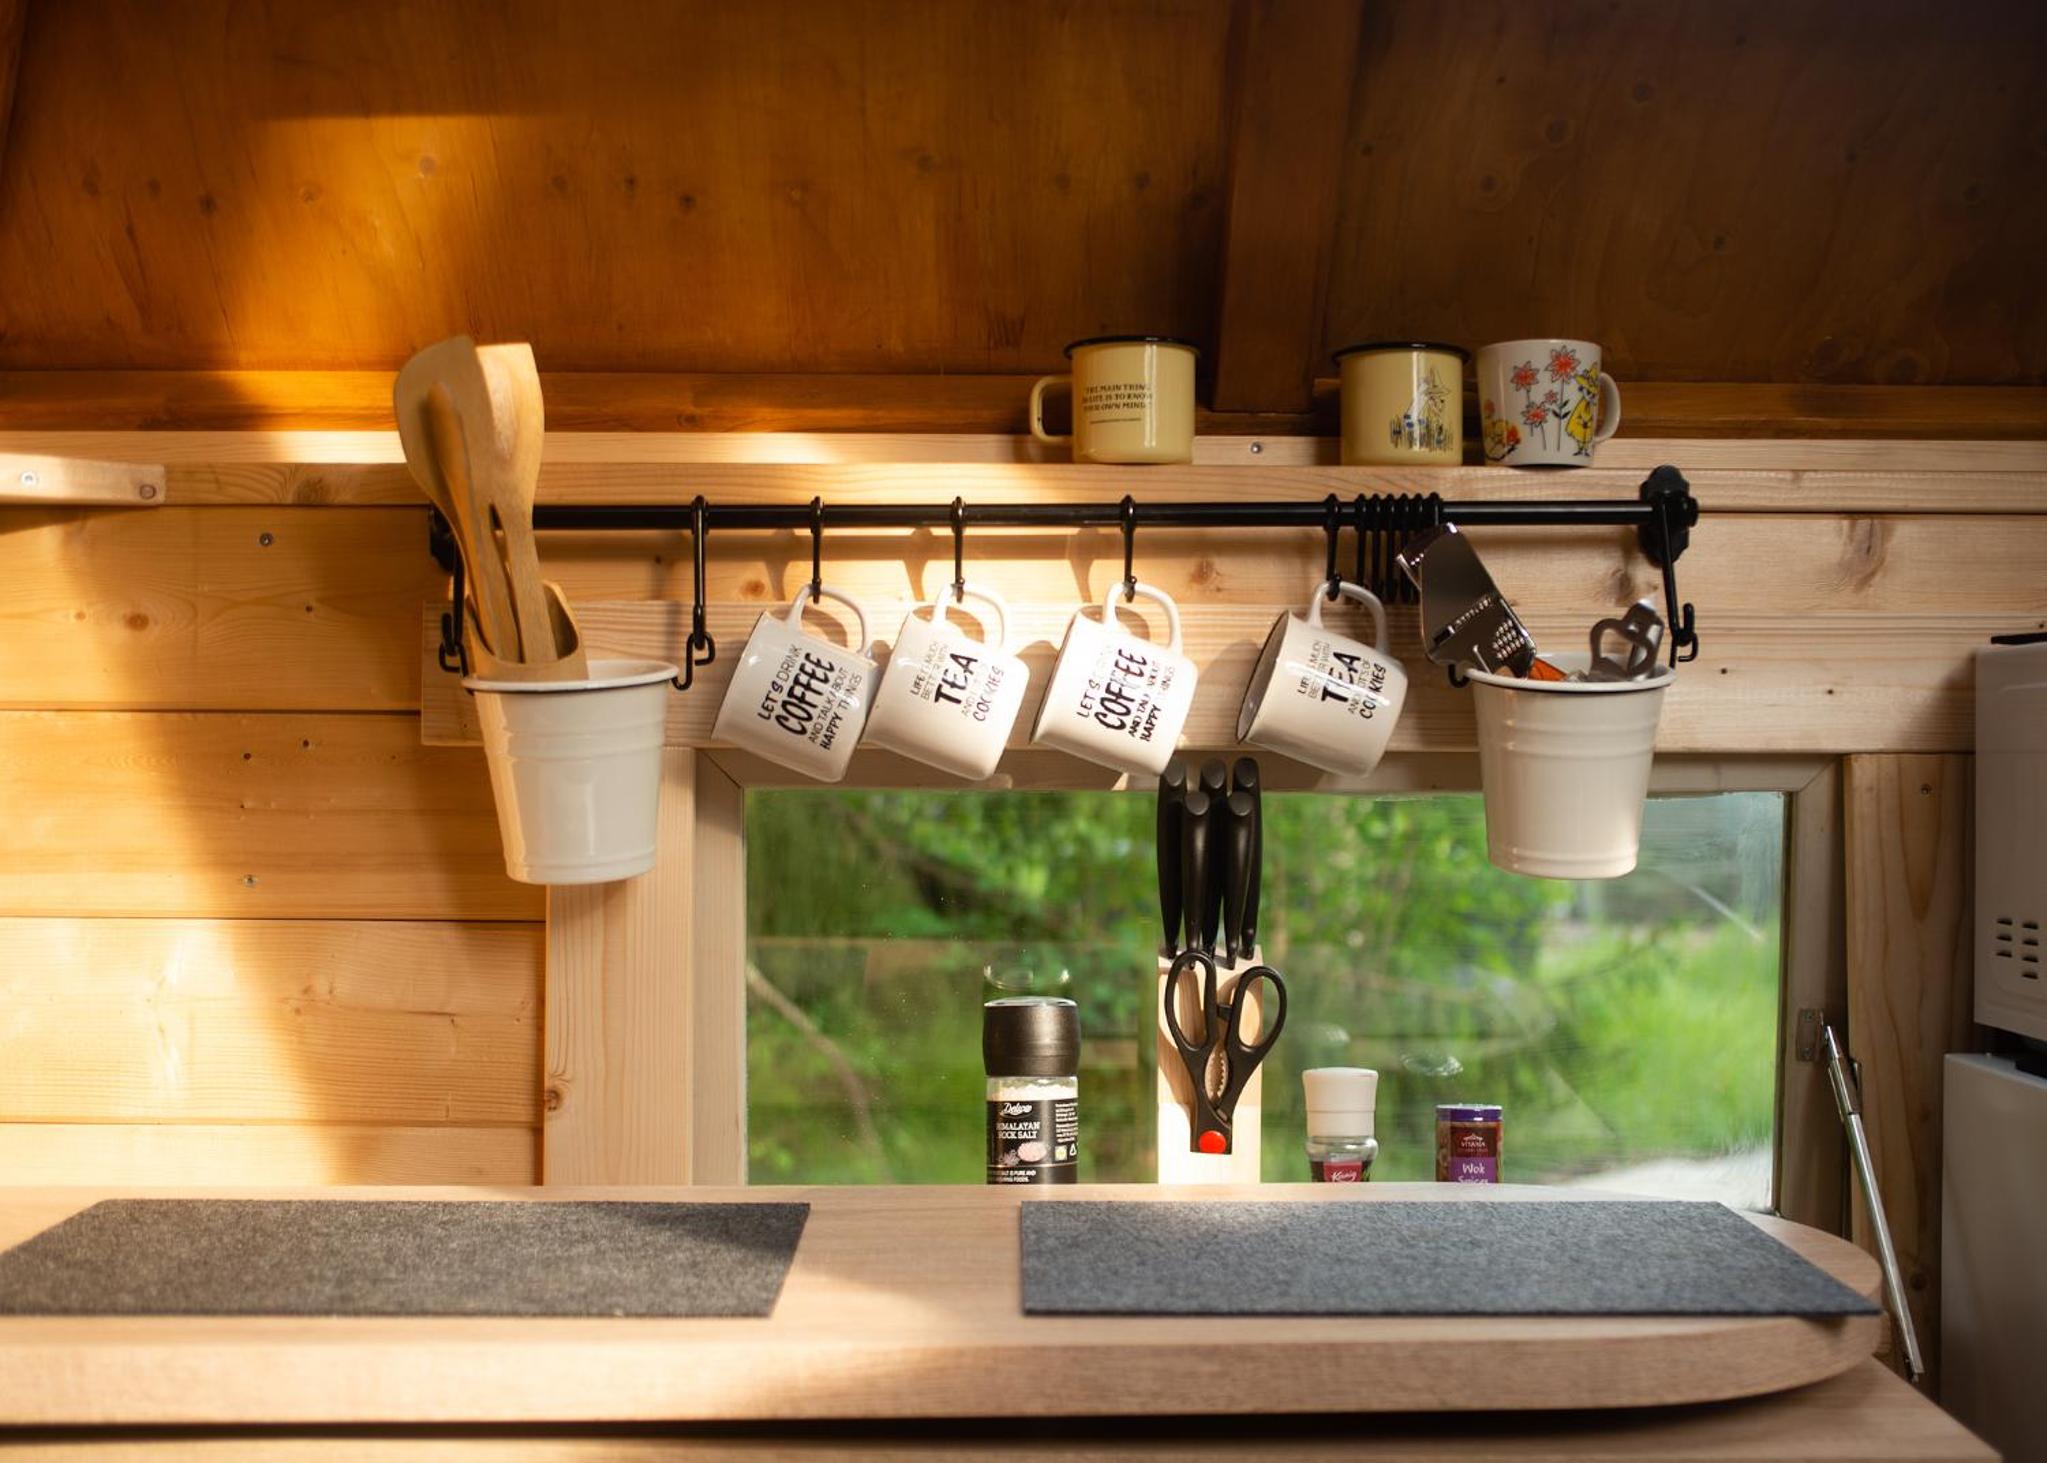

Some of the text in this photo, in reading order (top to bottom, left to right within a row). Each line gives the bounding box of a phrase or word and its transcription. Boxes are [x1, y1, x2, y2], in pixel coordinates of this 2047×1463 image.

[757, 644, 802, 721] LET'S DRINK
[774, 652, 835, 736] COFFEE
[910, 675, 926, 696] LIFE
[934, 653, 978, 704] TEA
[1094, 649, 1147, 731] COFFEE
[1321, 652, 1361, 702] TEA
[807, 721, 824, 744] AND
[817, 698, 834, 722] TALK
[819, 712, 843, 751] HAPPY
[1140, 704, 1162, 742] HAPPY
[1017, 1130, 1038, 1139] SALT
[1462, 1162, 1485, 1174] Wok
